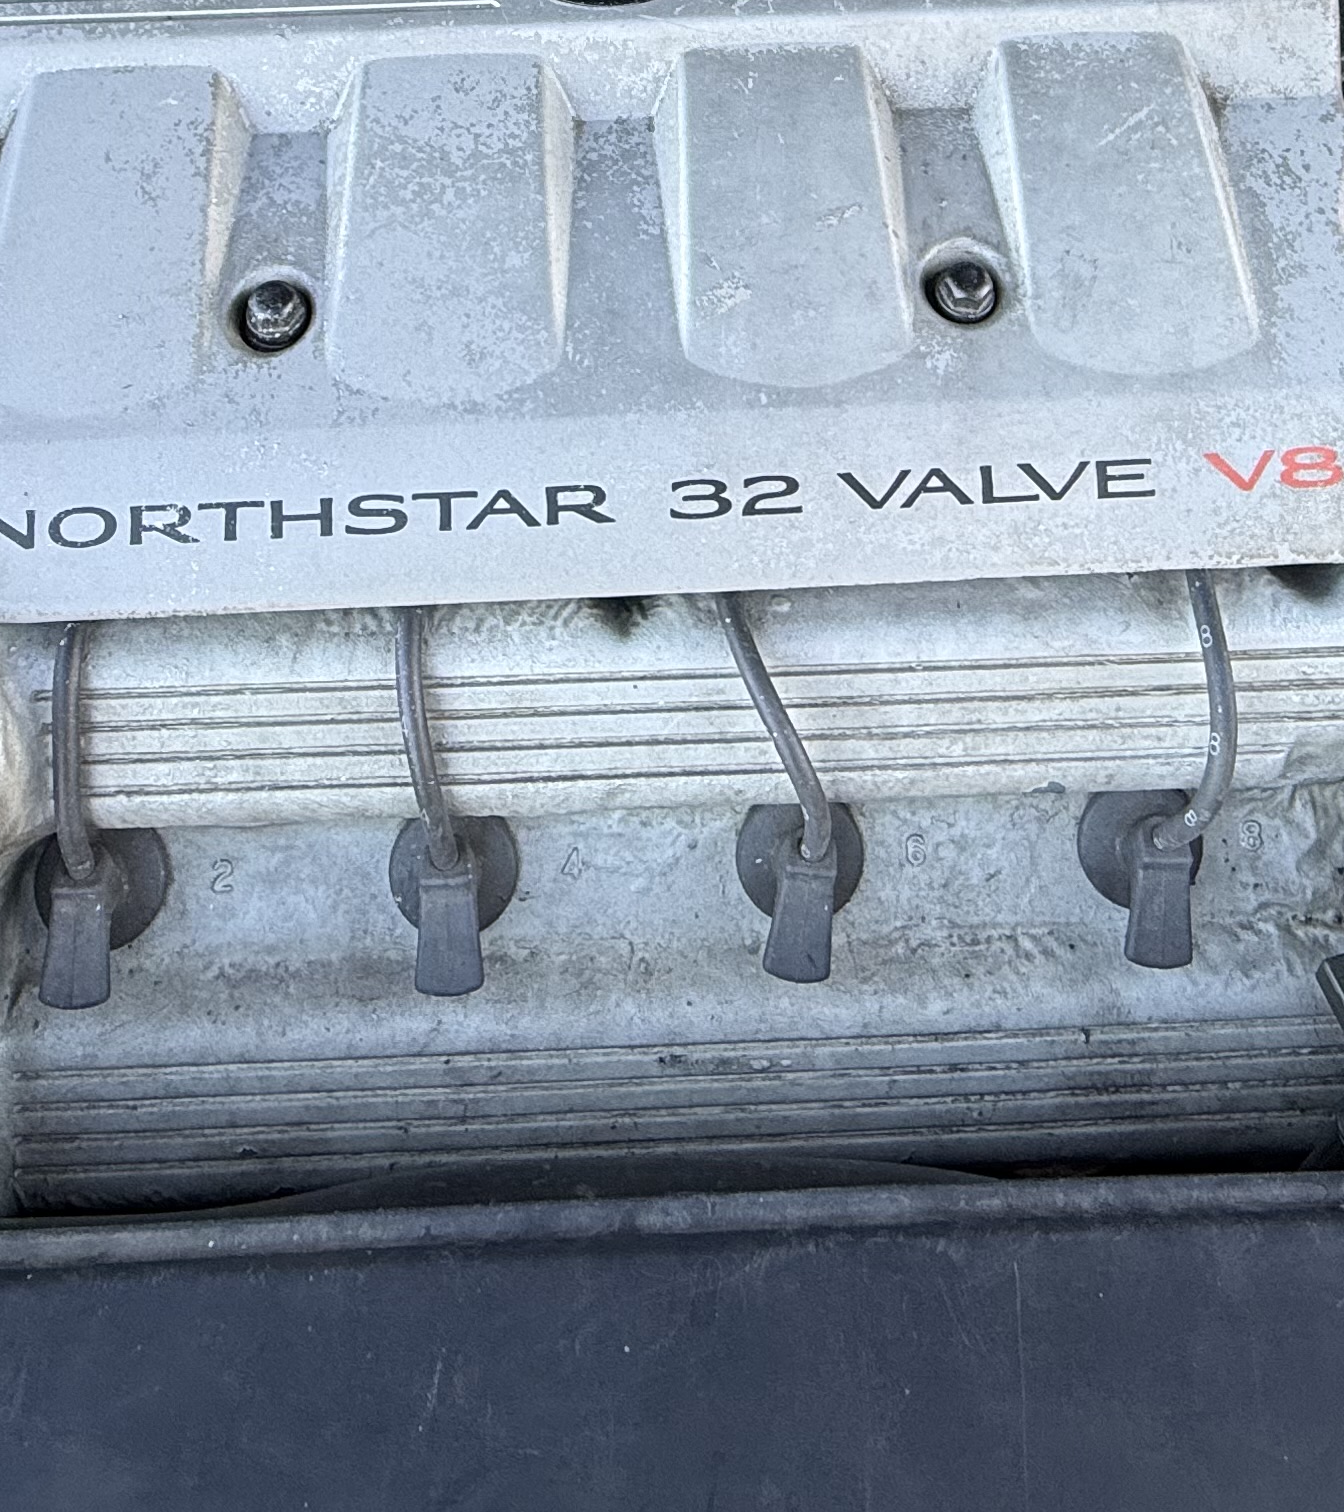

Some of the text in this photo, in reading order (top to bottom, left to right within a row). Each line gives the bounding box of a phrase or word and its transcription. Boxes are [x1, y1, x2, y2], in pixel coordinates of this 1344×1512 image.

[670, 475, 803, 520] 32
[836, 458, 1156, 510] VALVE
[1205, 447, 1344, 491] V8
[210, 858, 236, 894] 2
